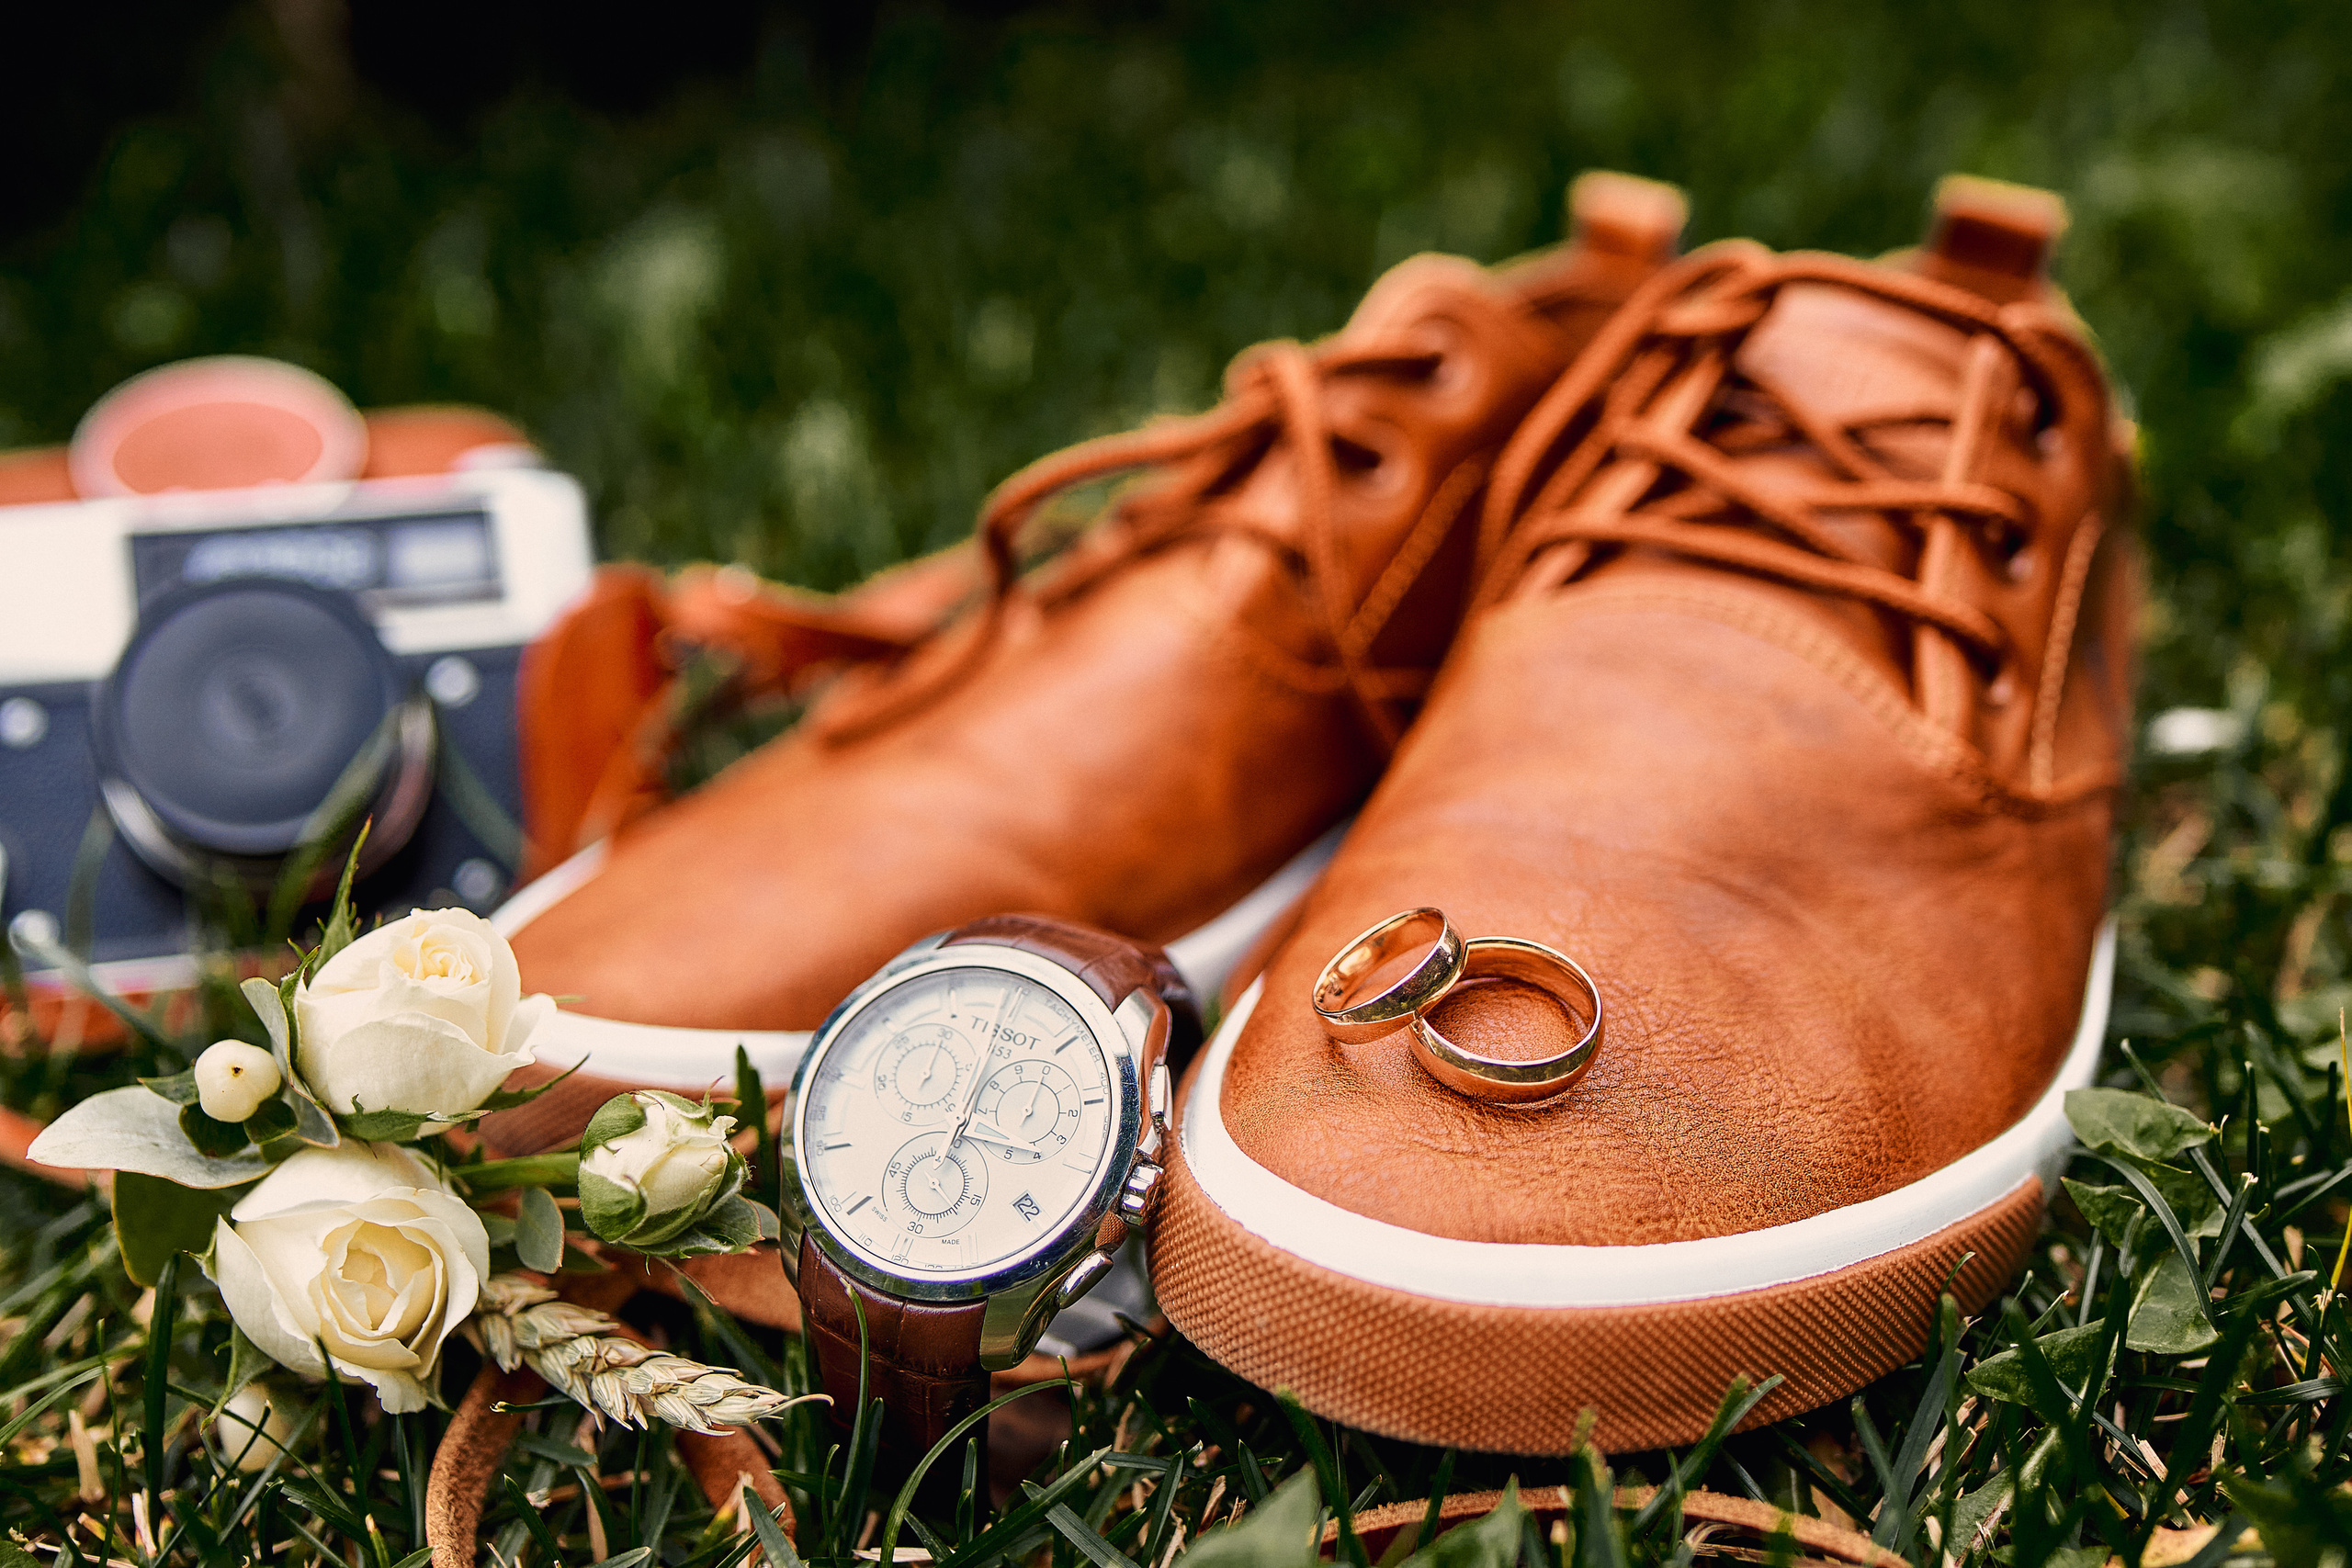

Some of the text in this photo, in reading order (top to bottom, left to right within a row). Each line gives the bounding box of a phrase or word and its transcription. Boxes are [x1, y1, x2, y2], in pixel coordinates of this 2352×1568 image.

[937, 1029, 953, 1040] 30
[971, 1015, 1041, 1050] TISSOT
[1045, 998, 1101, 1064] TACHYMETER
[1014, 1065, 1023, 1075] 9
[1041, 1065, 1051, 1076] 0
[989, 1080, 1000, 1090] 8
[900, 1111, 913, 1122] 15
[978, 1107, 989, 1115] 7
[1068, 1109, 1079, 1118] 2
[1056, 1134, 1067, 1145] 3
[1003, 1149, 1014, 1160] 5
[888, 1161, 901, 1179] 45
[829, 1194, 842, 1213] 100
[969, 1193, 982, 1207] 15
[871, 1206, 888, 1223] SWISS
[1016, 1198, 1040, 1222] 22
[907, 1221, 924, 1235] 30
[858, 1233, 873, 1247] 110
